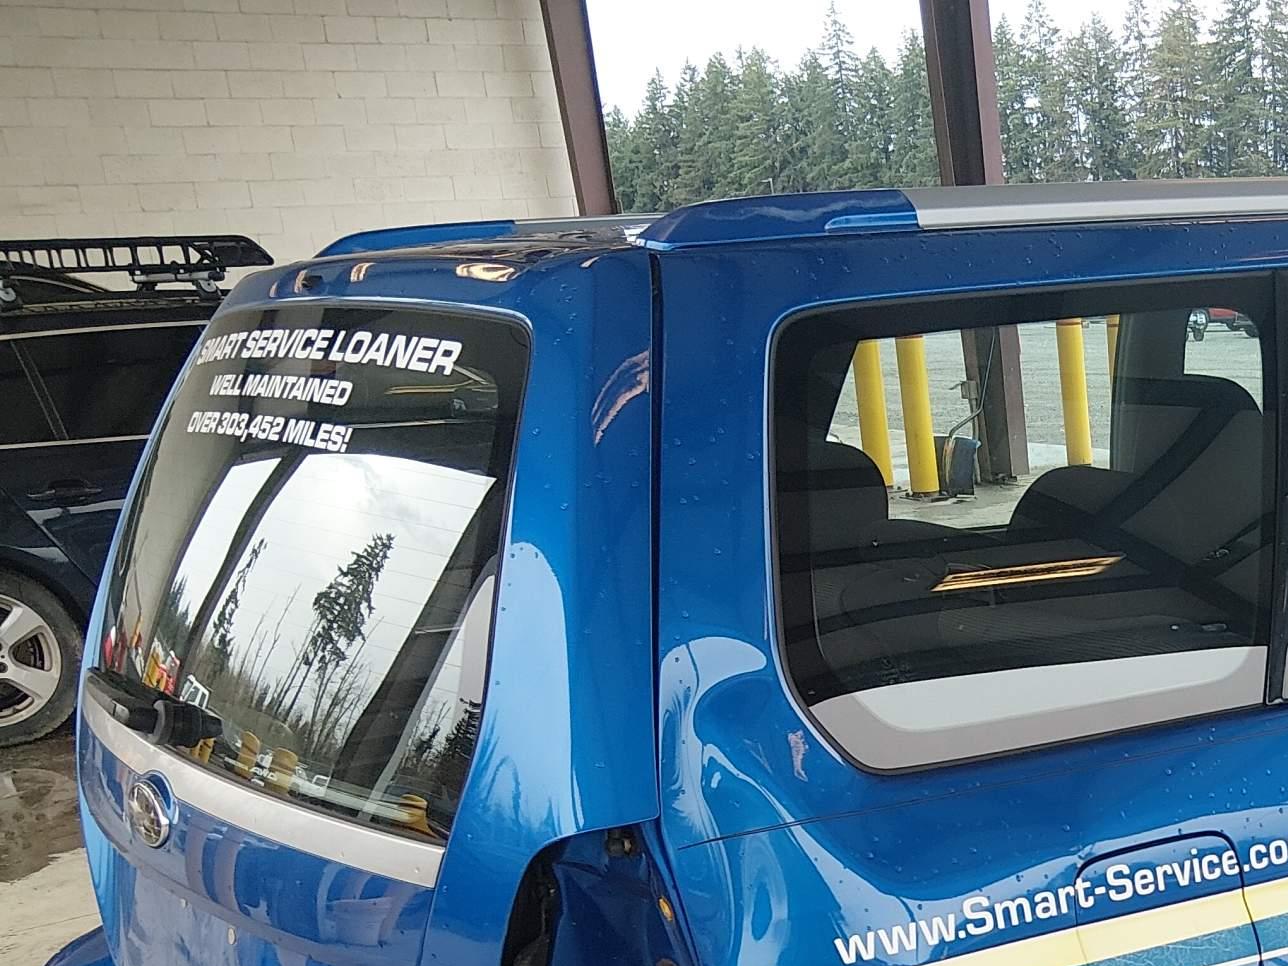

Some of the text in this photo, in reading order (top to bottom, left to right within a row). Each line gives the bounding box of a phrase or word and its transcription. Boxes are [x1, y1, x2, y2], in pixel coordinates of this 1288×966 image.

[196, 328, 463, 376] SMART SERVICE LOANER
[208, 374, 353, 407] WELL MAINTAINED
[186, 411, 354, 453] OVER 303,452 MILES!
